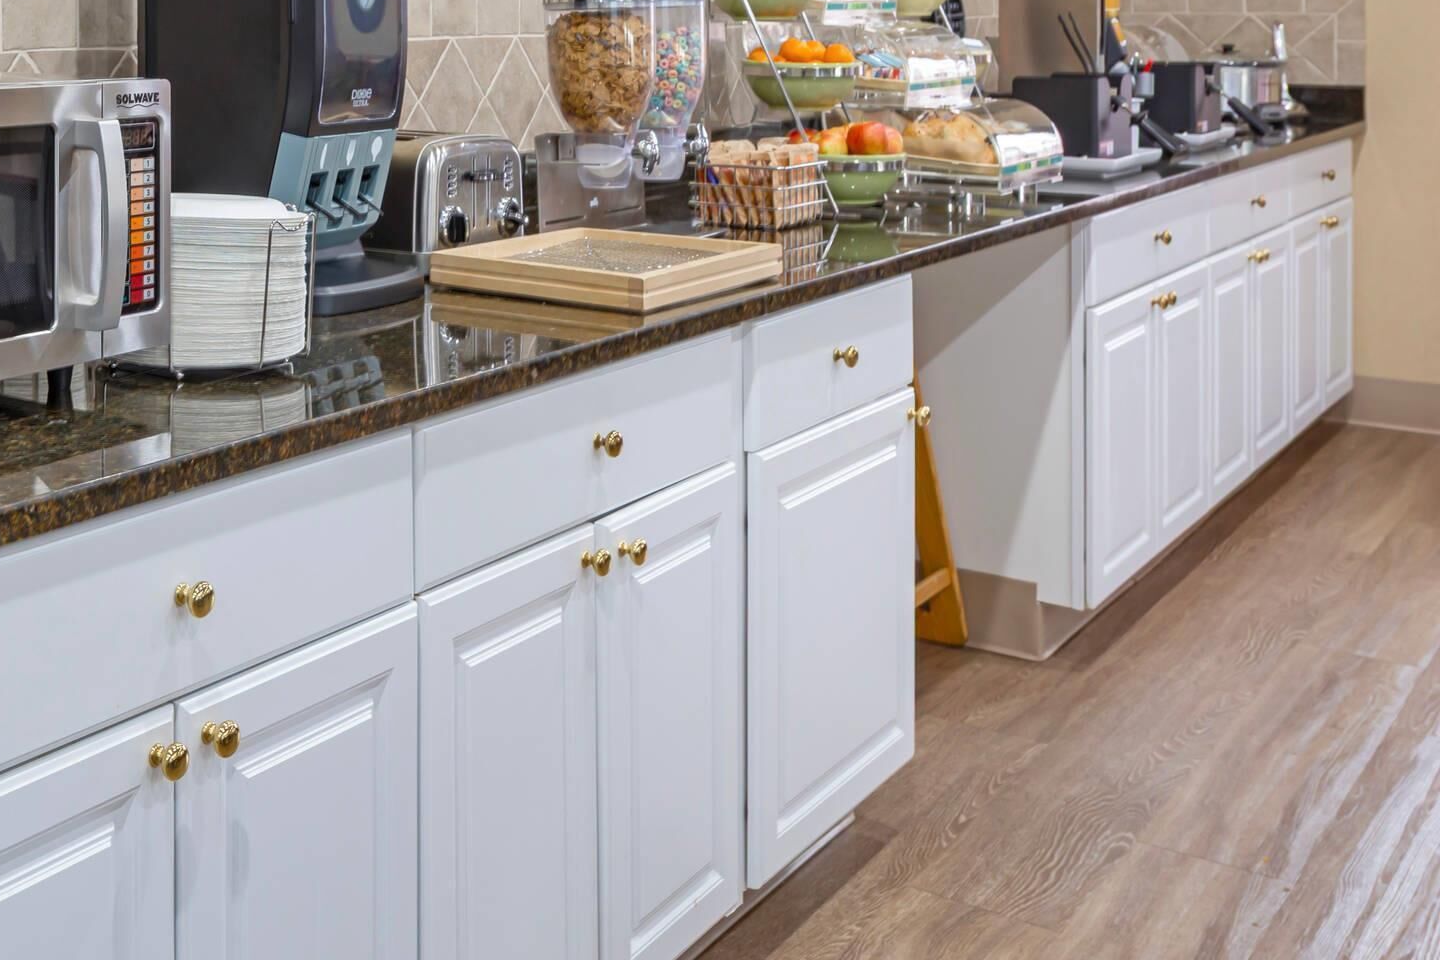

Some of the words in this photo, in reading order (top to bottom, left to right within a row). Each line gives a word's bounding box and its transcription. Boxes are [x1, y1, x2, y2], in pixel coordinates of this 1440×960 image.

[116, 93, 160, 105] SOLWAVE
[146, 174, 150, 182] 2
[146, 188, 150, 196] 3
[146, 232, 150, 240] 6
[146, 261, 150, 269] 8
